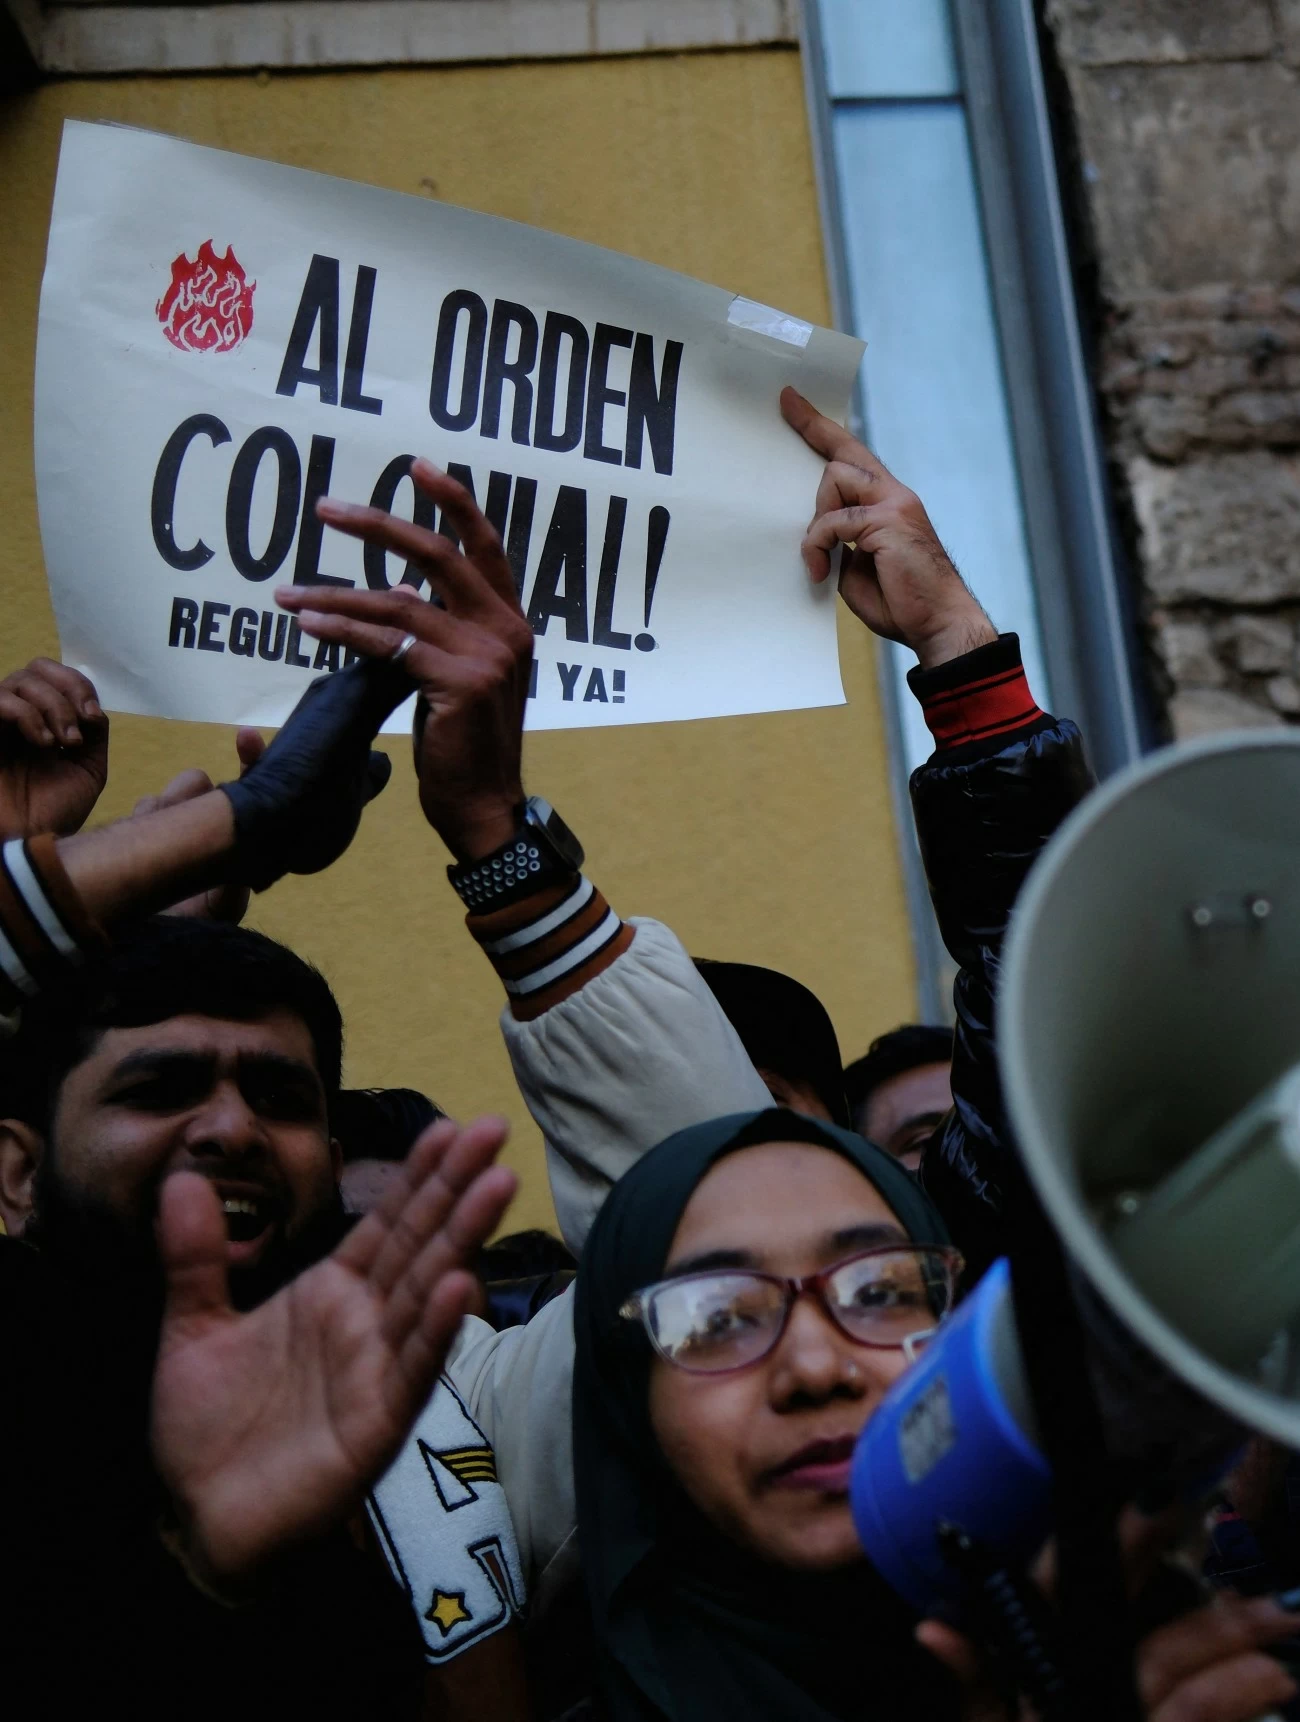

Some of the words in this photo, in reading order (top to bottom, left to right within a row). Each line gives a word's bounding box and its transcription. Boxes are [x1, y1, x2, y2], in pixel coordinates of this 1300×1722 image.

[275, 253, 383, 415] AL
[429, 288, 685, 476] ORDEN
[556, 662, 626, 703] YA!
